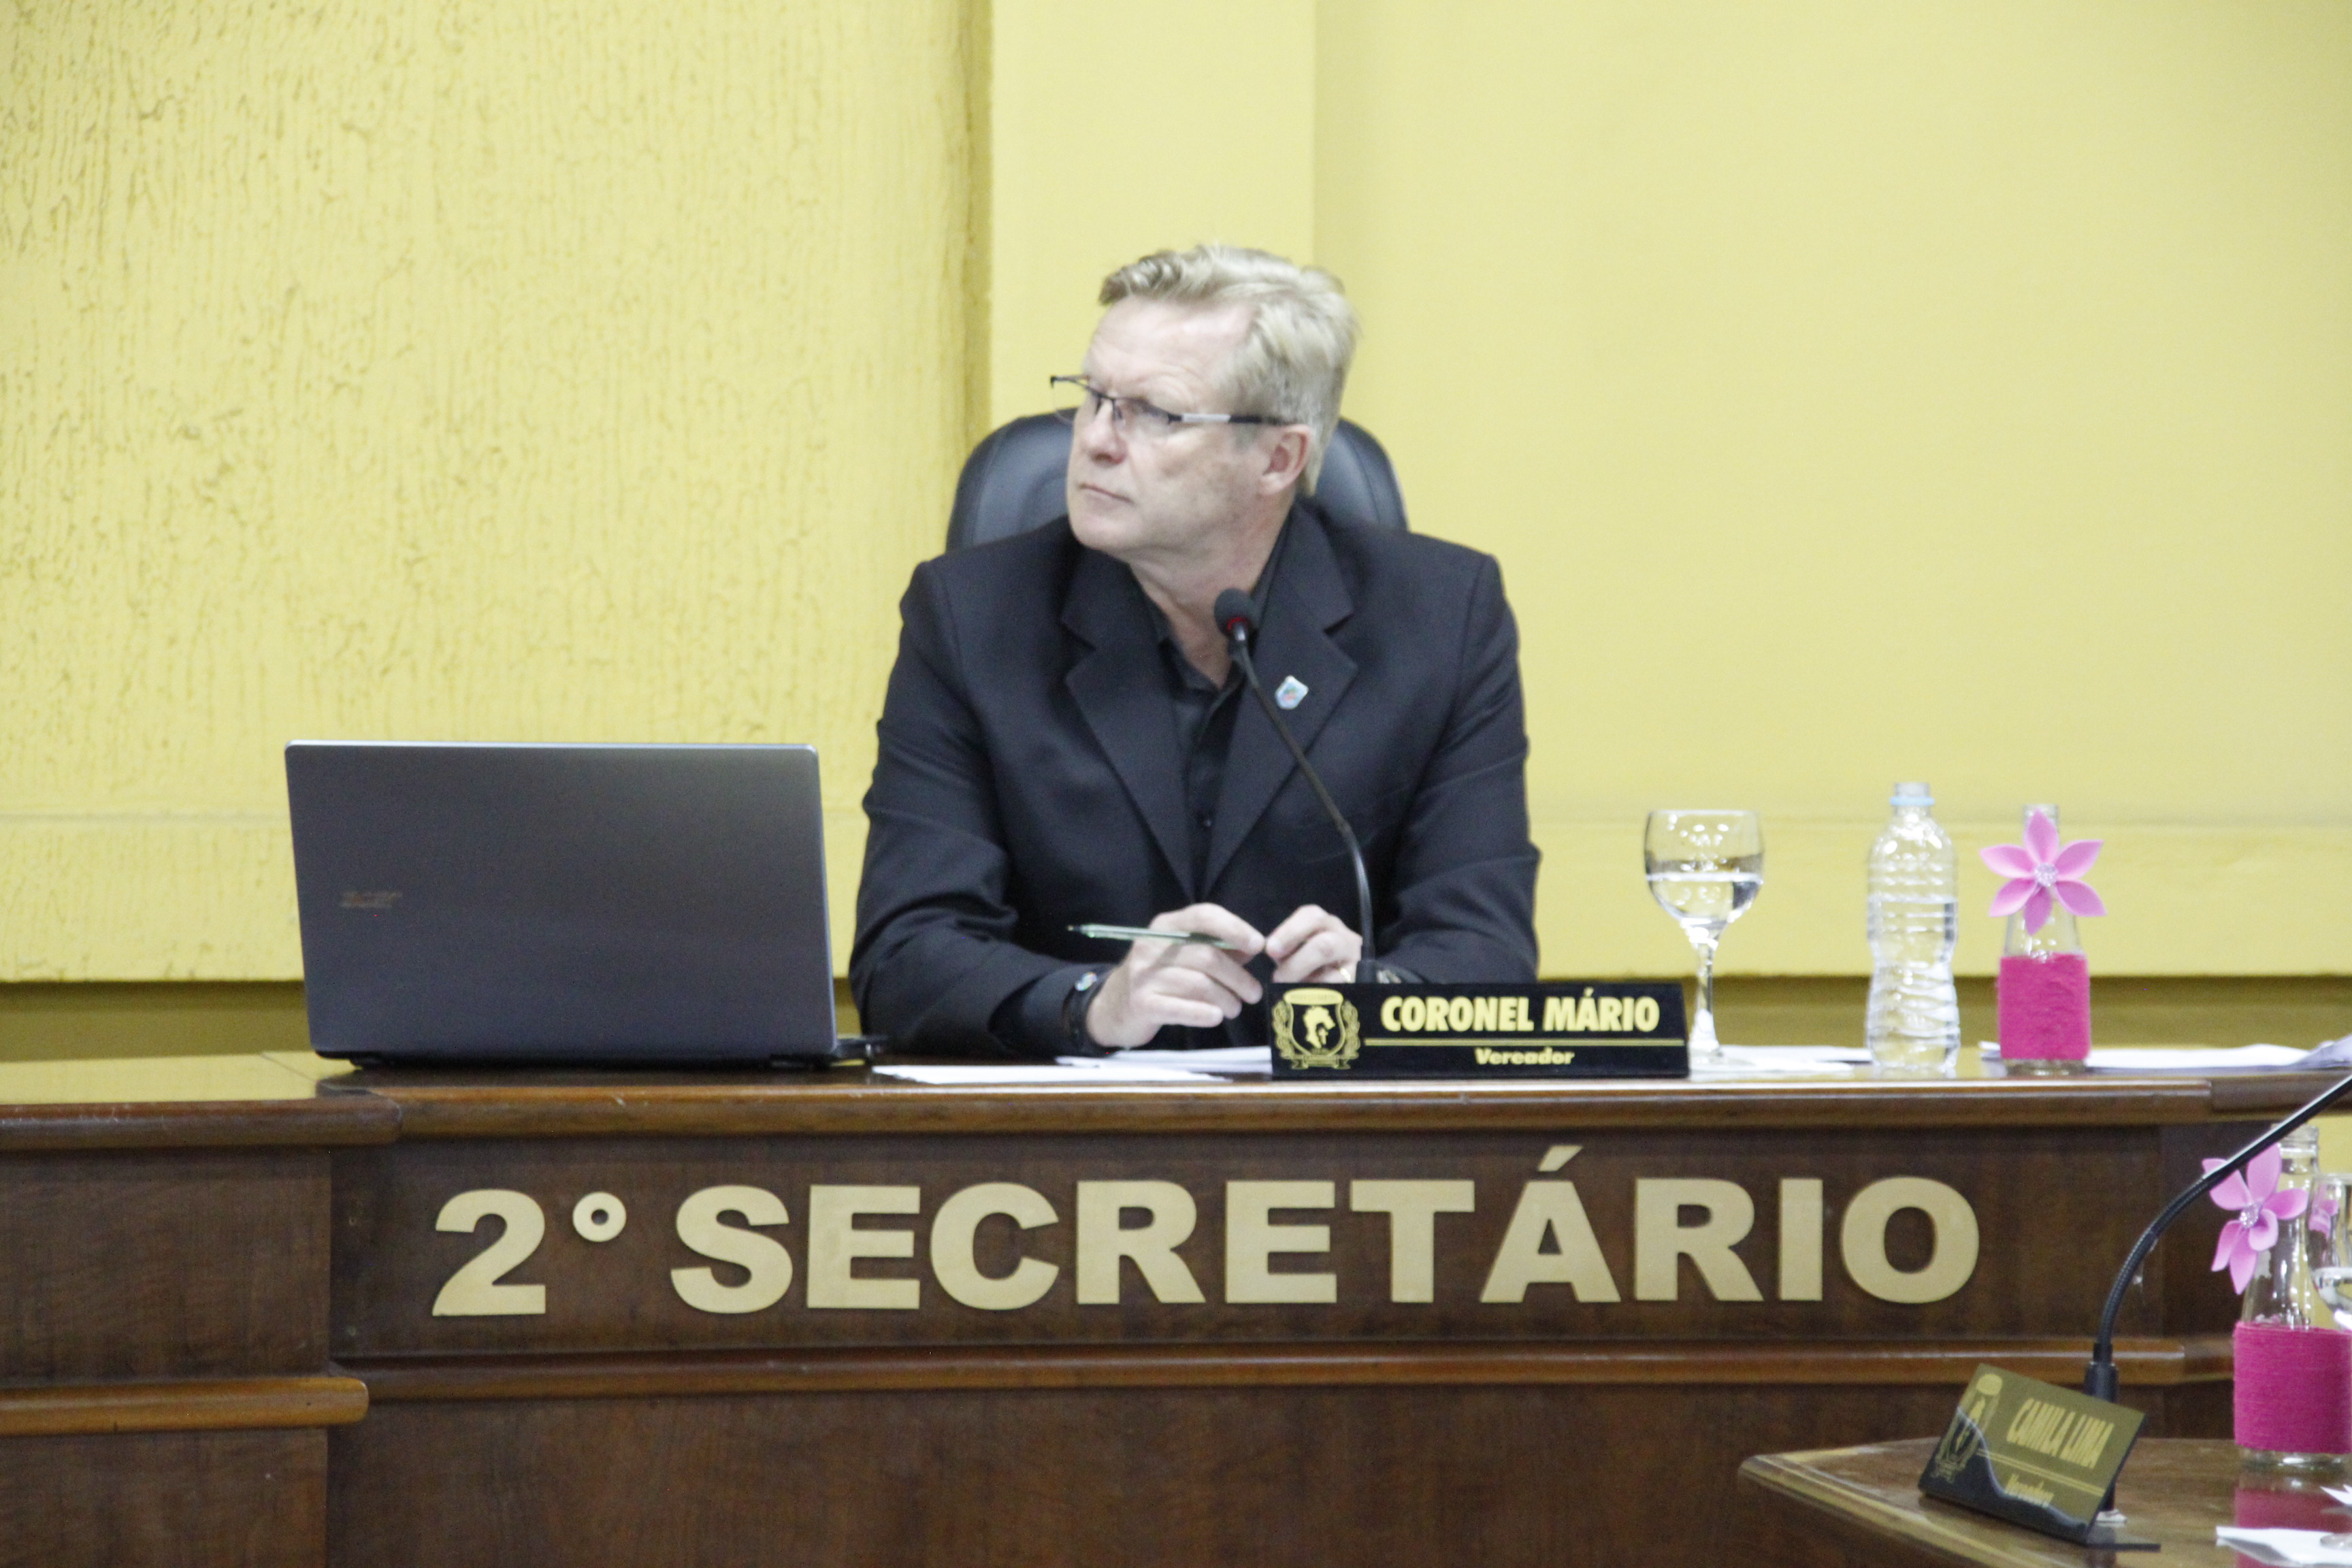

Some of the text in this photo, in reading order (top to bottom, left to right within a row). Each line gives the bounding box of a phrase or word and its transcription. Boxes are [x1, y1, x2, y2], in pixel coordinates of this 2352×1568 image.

[1381, 996, 1534, 1031] CORONEL
[1543, 988, 1659, 1032] MÁRIO
[1475, 1046, 1575, 1064] Vereador
[671, 1146, 1978, 1313] SECRETÁRIO
